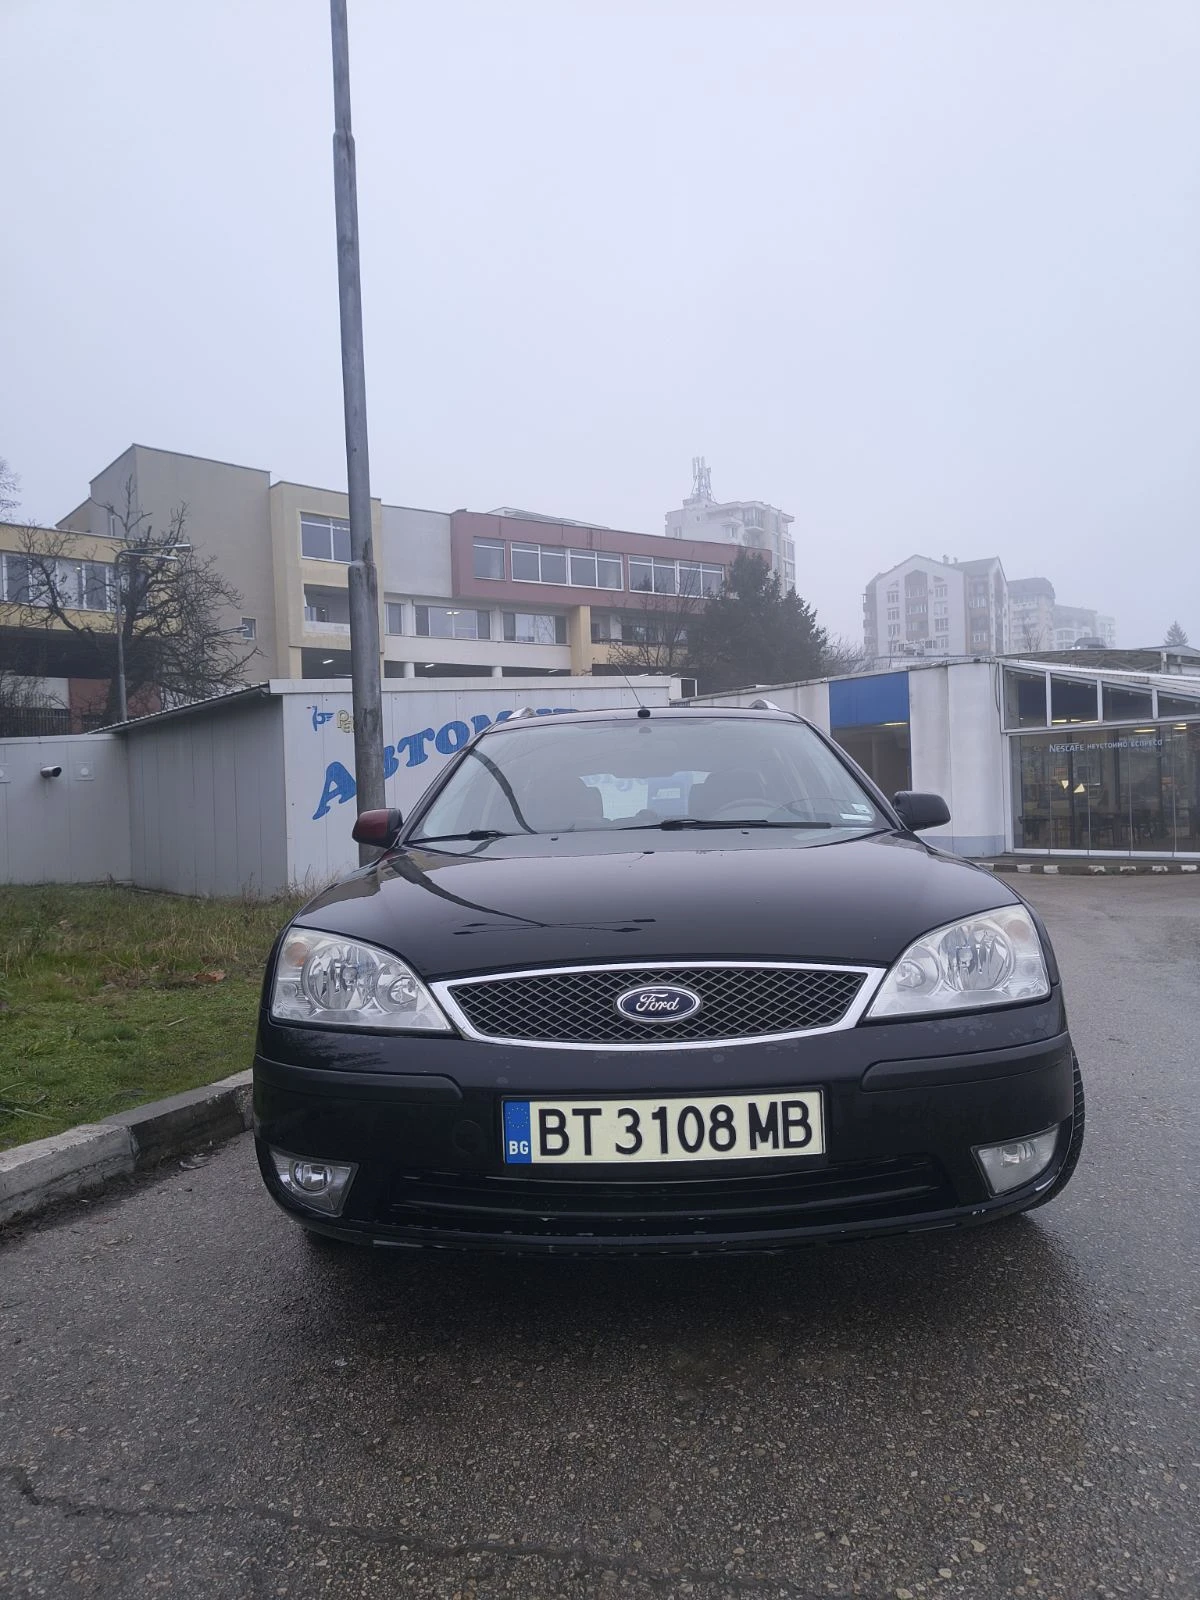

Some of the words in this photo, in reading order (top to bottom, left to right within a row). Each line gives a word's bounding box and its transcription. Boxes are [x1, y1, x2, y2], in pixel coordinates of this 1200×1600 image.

[636, 993, 680, 1011] Ford
[538, 1107, 602, 1156] BT
[615, 1104, 737, 1155] 3108
[748, 1100, 812, 1151] MB
[509, 1141, 529, 1155] BG
